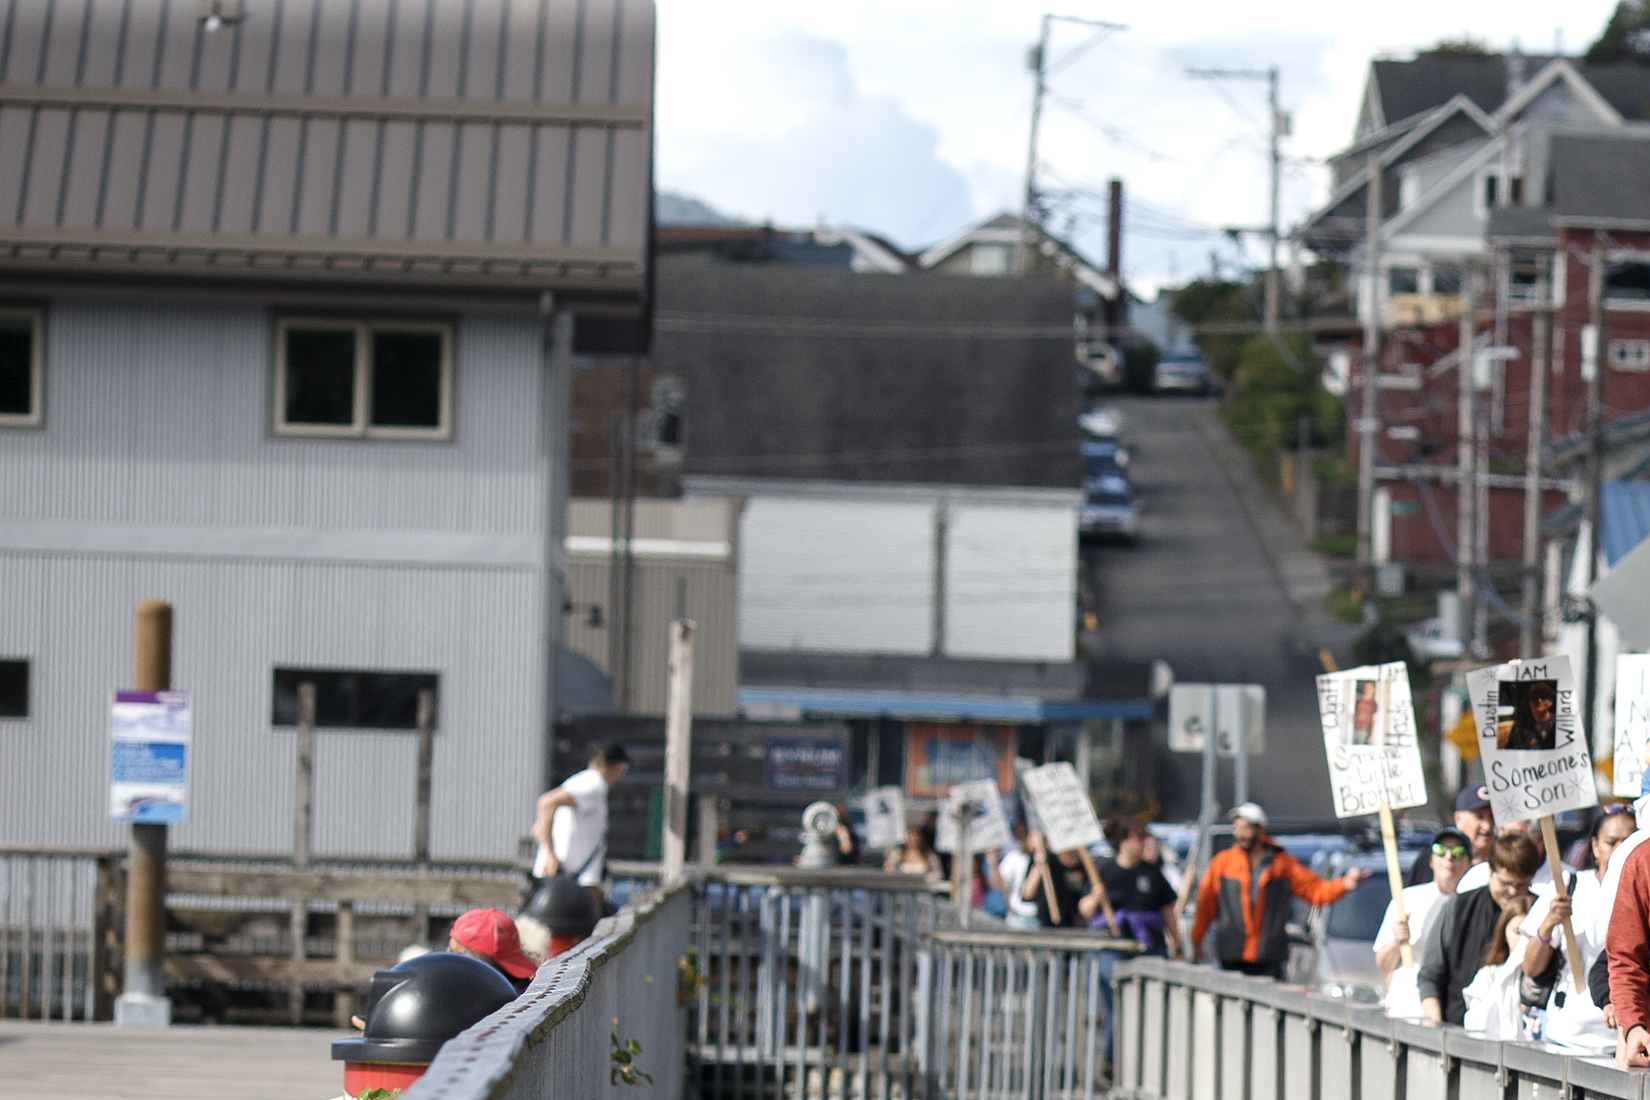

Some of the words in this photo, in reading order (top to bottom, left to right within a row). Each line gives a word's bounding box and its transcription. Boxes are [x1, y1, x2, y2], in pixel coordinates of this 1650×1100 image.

[1521, 664, 1548, 679] AM
[1478, 690, 1497, 738] Dustin
[1556, 690, 1574, 749] Willard
[1492, 753, 1588, 792] Someone's
[1524, 783, 1566, 810] Son
